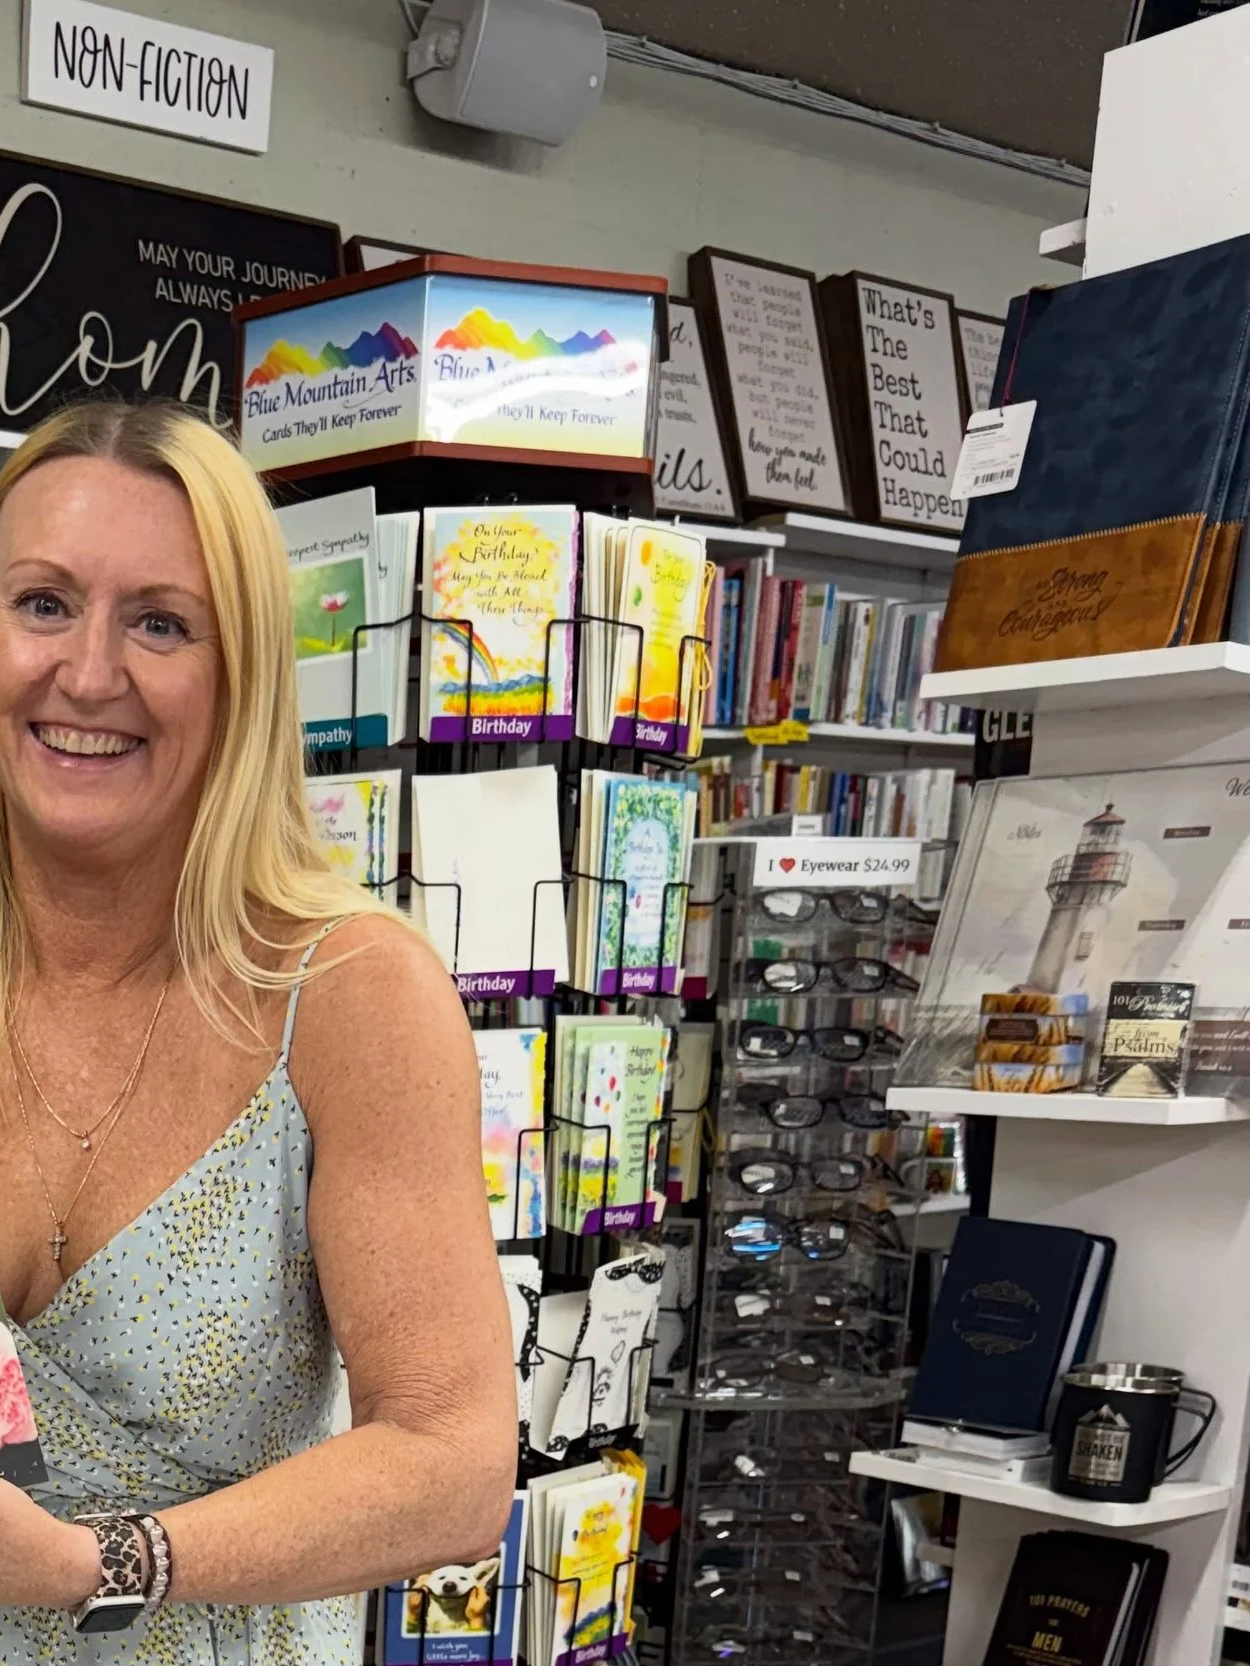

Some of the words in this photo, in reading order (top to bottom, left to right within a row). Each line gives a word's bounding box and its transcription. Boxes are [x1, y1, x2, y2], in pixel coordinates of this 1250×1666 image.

[54, 21, 249, 119] NON-FICTION
[138, 239, 179, 267] MAY
[183, 250, 236, 280] YOUR
[155, 278, 233, 312] ALWAYS
[863, 287, 936, 329] What's
[866, 326, 908, 360] The
[871, 364, 921, 400] Best
[244, 388, 281, 419] Blue
[285, 375, 367, 409] Mountain
[263, 420, 292, 442] Cards
[295, 413, 328, 437] They'll
[332, 411, 357, 430] Keep
[359, 404, 401, 424] Forever
[875, 401, 928, 439] That
[748, 427, 771, 453] how
[775, 446, 796, 465] you
[799, 445, 826, 467] made
[879, 440, 947, 478] Could
[766, 461, 792, 484] them
[321, 531, 370, 554] Sympathy
[473, 524, 490, 537] On
[494, 525, 521, 539] Your
[452, 572, 472, 588] May
[475, 572, 491, 585] You
[497, 570, 508, 580] Be
[1039, 567, 1109, 601] Strong
[999, 588, 1108, 642] Courageous
[304, 727, 352, 747] ympathy
[472, 719, 532, 736] Birthday
[636, 724, 668, 745] Birthday
[768, 859, 773, 872] I
[800, 858, 860, 875] Eyewear
[863, 858, 910, 874] $24.99
[457, 974, 516, 993] Birthday
[622, 972, 656, 989] Birthday
[1113, 995, 1130, 1006] 101
[1135, 1029, 1159, 1039] from
[1113, 1036, 1176, 1056] Psalms
[604, 1211, 636, 1226] Birthday
[1076, 1440, 1123, 1463] SHAKEN
[1047, 1595, 1091, 1618] PRAYERS
[1031, 1631, 1063, 1653] MEN
[575, 1644, 608, 1664] Birthday
